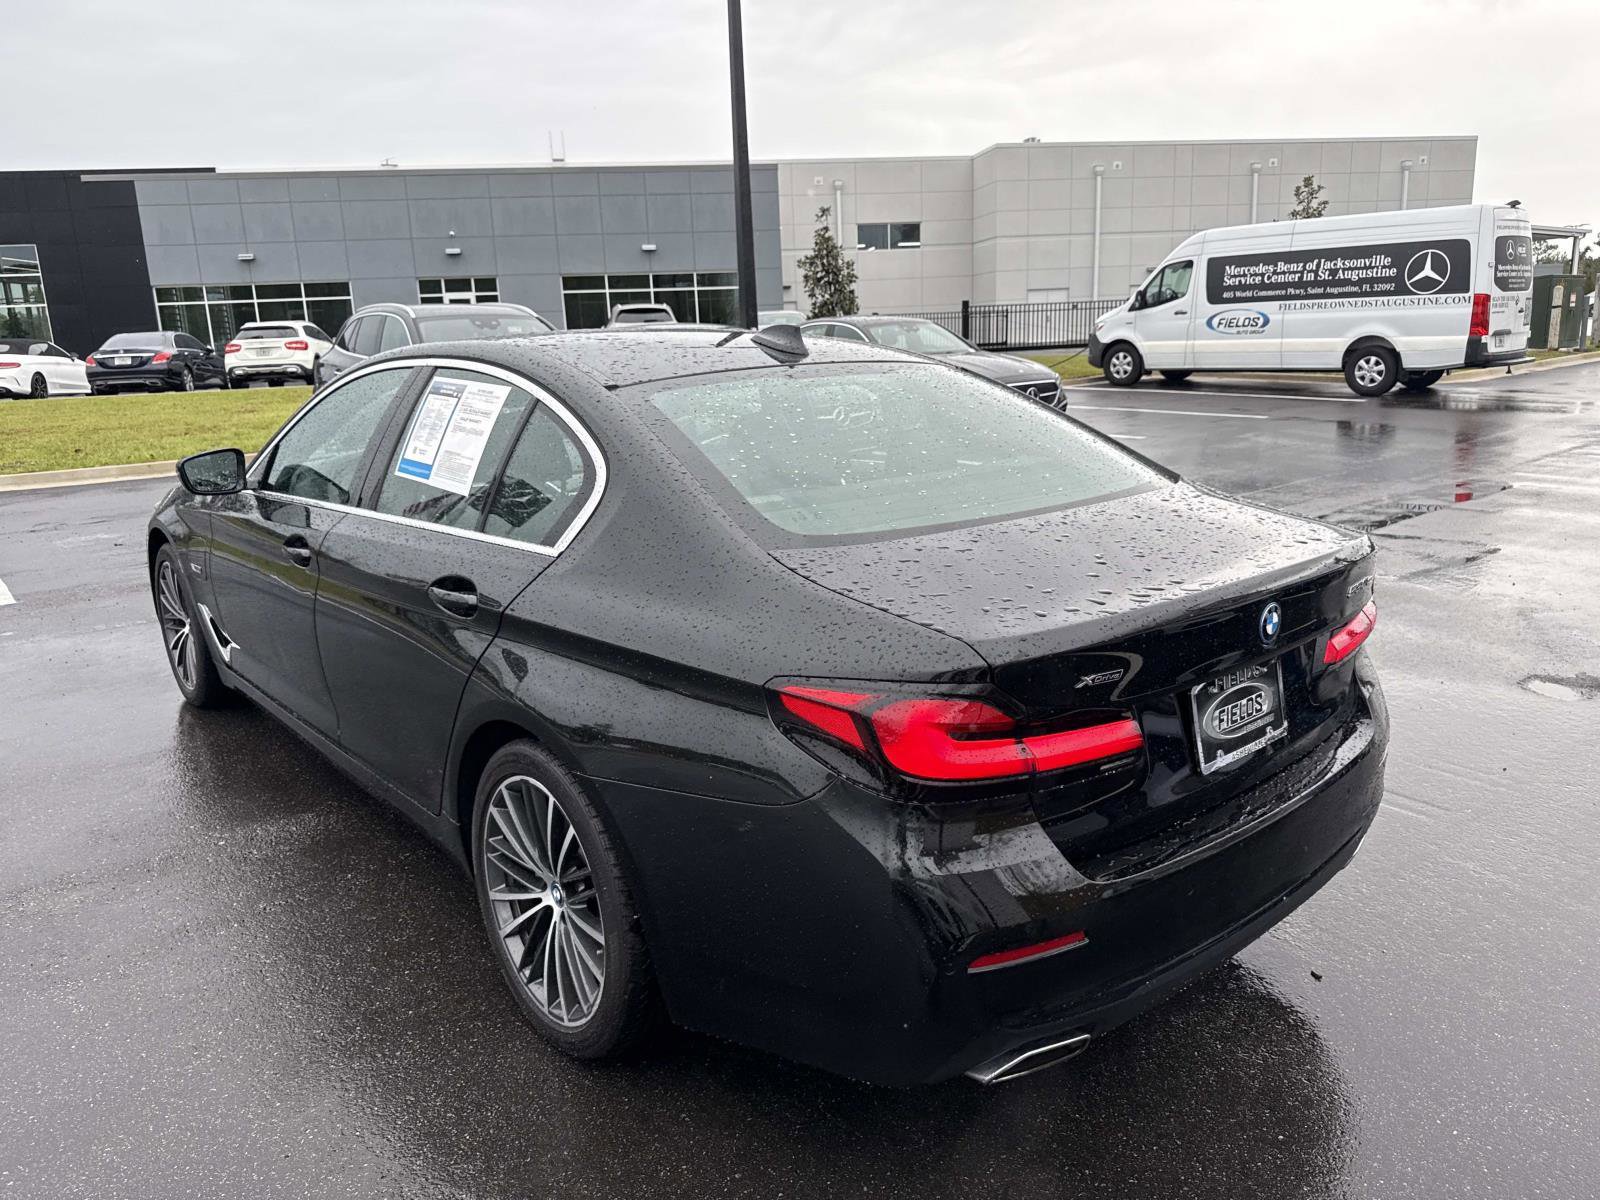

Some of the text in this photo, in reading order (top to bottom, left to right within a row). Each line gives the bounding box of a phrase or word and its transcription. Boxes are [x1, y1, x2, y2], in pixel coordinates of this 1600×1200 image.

[1224, 255, 1391, 276] Mercedes-Benz of Jacksonville
[1223, 265, 1397, 286] Service Center in St. Augustine
[1222, 290, 1235, 299] 405
[1235, 289, 1253, 298] World
[1253, 287, 1286, 297] Commerce
[1307, 285, 1324, 294] Saint
[1325, 283, 1361, 294] Augustine,
[1362, 283, 1371, 292] FL
[1373, 282, 1396, 291] 32092
[1278, 295, 1472, 311] FIELDSPREOWNEDSTAUGUSTINE.COM
[1216, 316, 1260, 328] FIELDS
[1218, 691, 1264, 734] FIELDS
